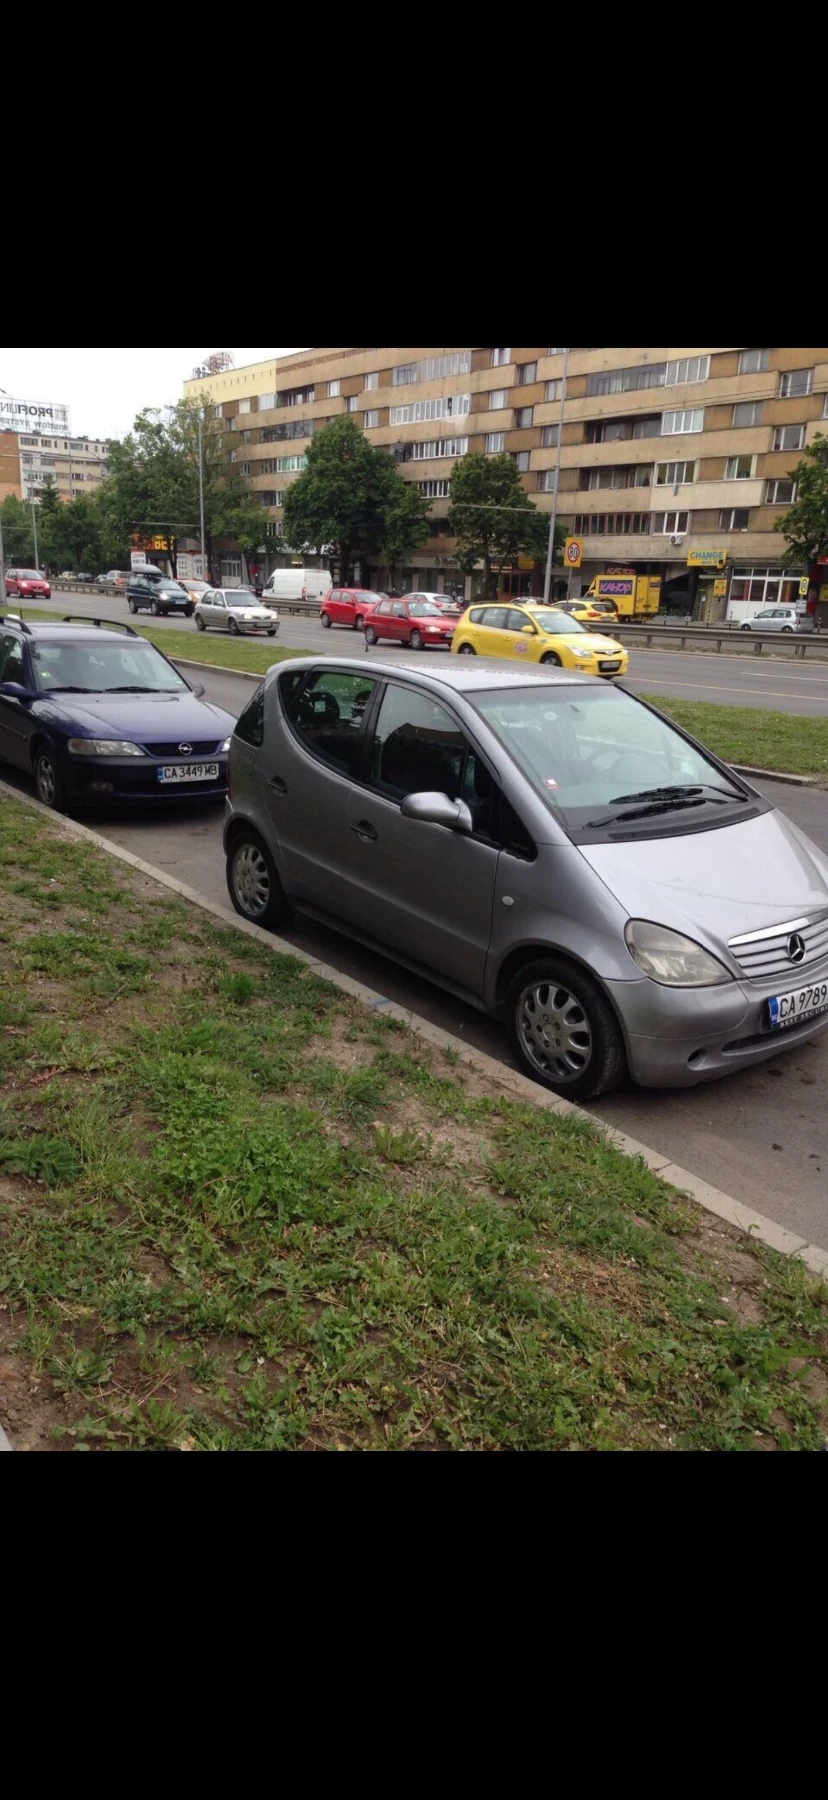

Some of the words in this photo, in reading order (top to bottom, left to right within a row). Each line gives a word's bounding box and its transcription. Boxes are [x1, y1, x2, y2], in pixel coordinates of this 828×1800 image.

[690, 551, 724, 560] CHANGE
[164, 767, 177, 779] CA
[179, 765, 203, 778] 3449
[204, 764, 217, 776] MB
[780, 995, 795, 1018] CA
[799, 984, 827, 1010] 9789
[780, 1016, 798, 1028] BEST
